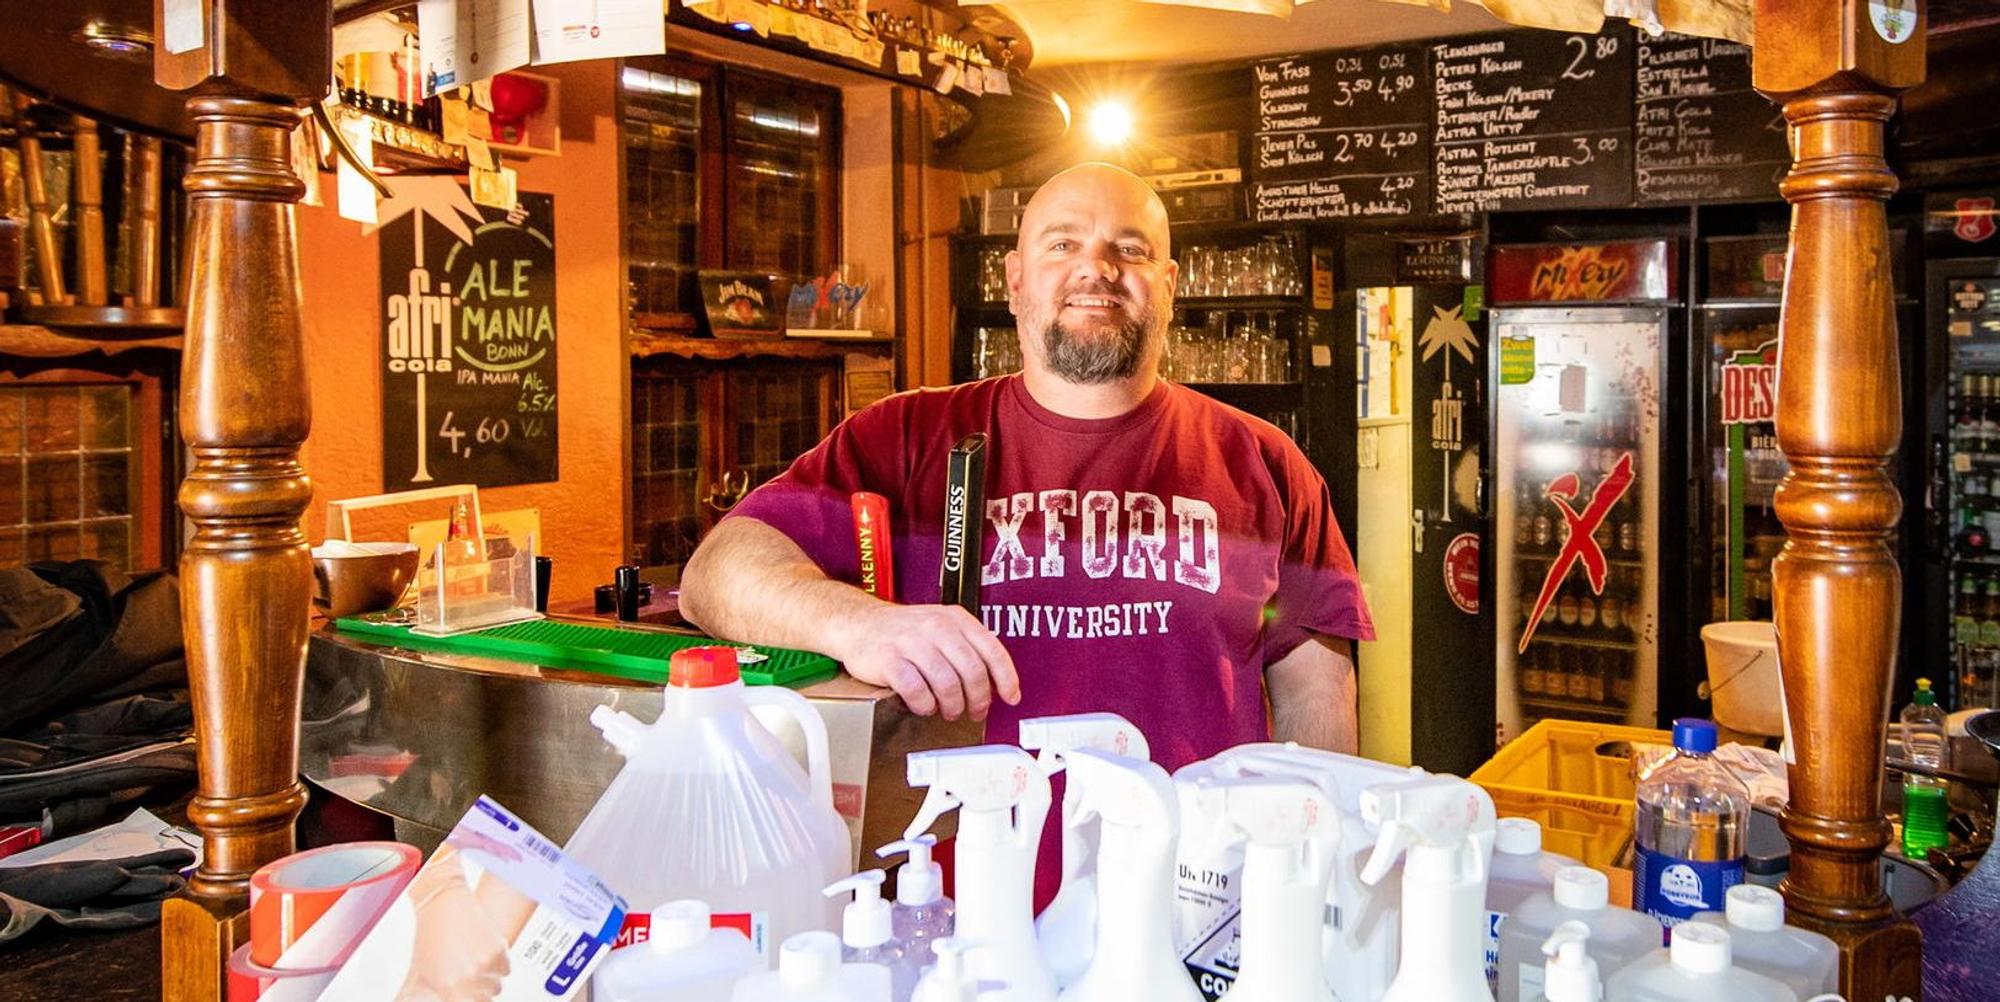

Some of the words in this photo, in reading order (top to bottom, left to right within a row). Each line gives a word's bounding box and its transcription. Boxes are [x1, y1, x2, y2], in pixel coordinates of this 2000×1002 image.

[460, 260, 533, 301] ALE
[461, 305, 555, 344] MANIA
[388, 358, 453, 372] cola
[486, 342, 530, 362] BONN
[944, 484, 965, 572] GUINNESS
[981, 489, 1223, 596] XFORD
[980, 601, 1174, 639] UNIVERSITY
[1202, 869, 1229, 890] 1719
